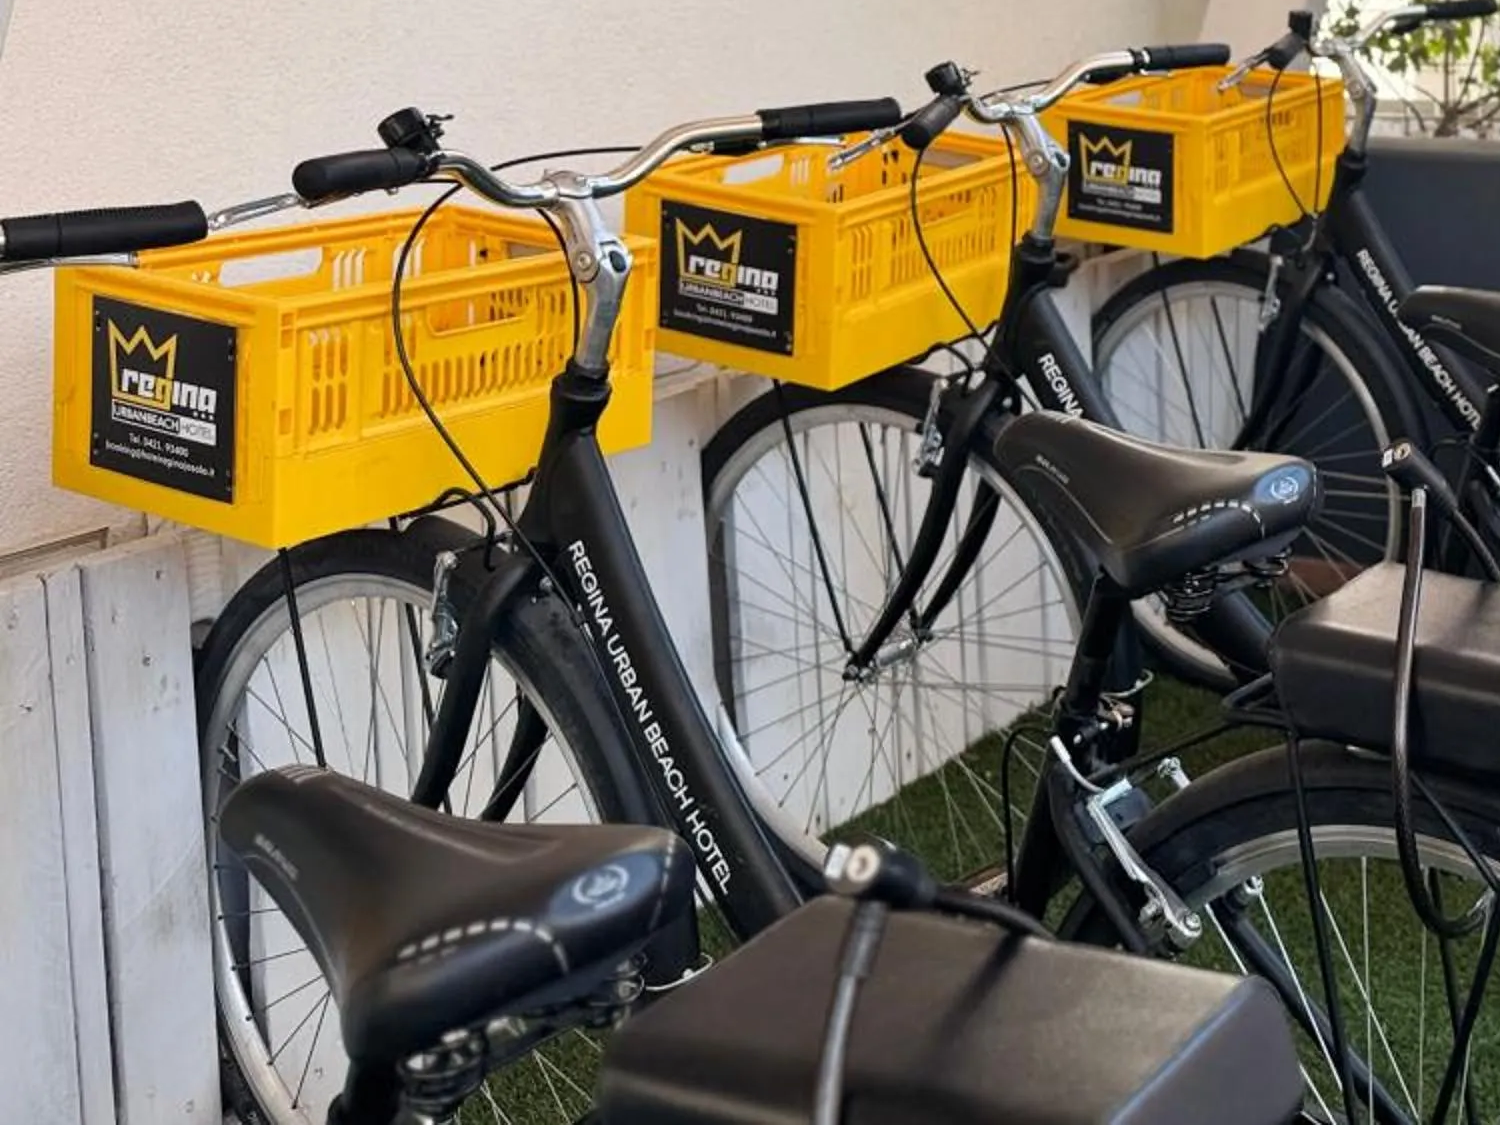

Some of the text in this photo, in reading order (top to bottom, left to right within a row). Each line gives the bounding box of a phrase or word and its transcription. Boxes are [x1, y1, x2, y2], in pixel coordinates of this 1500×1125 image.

[688, 255, 779, 290] regina
[121, 368, 217, 414] regina
[568, 540, 732, 895] REGINA URBAN BEACH HOTEL
